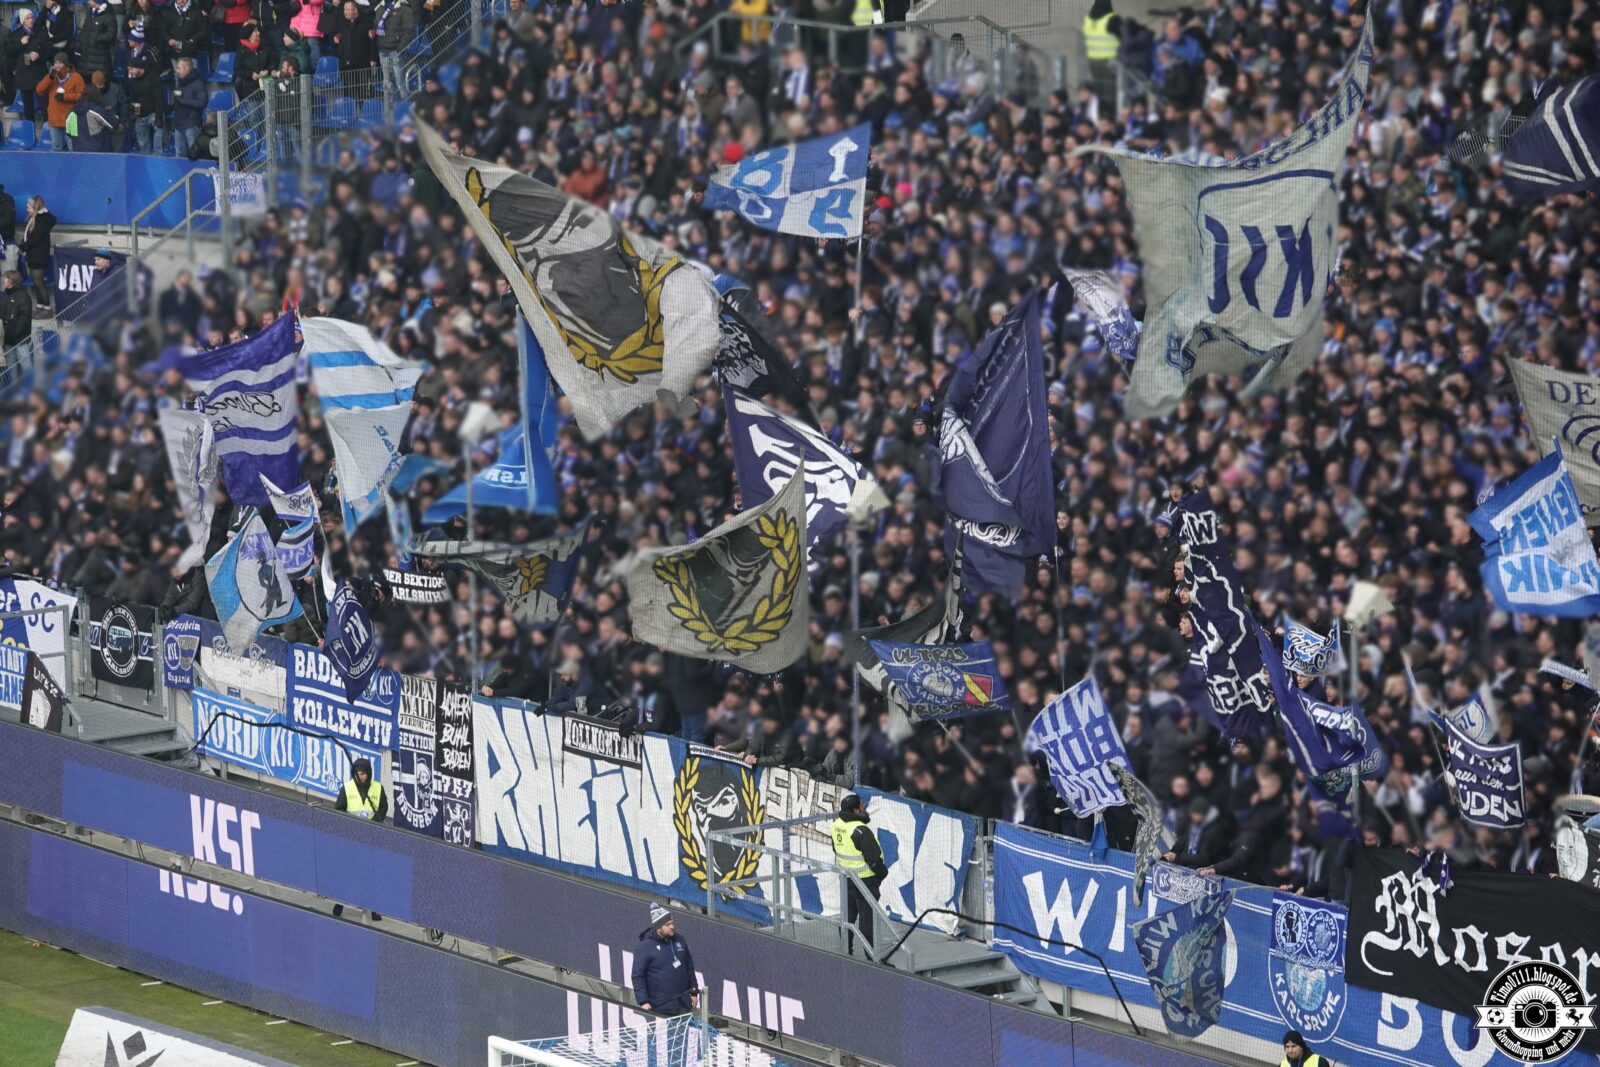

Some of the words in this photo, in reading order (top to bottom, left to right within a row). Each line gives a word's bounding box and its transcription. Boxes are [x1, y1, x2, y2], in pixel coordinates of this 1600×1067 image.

[28, 592, 57, 633] SC
[294, 649, 345, 690] BADE
[891, 647, 969, 664] ULTRAS
[293, 697, 393, 747] KOLLEKTIV
[401, 694, 435, 720] WALD
[197, 697, 259, 760] NORD
[270, 724, 295, 768] KSC
[399, 731, 434, 752] SEKTION
[305, 735, 376, 787] BAD
[1455, 769, 1477, 784] aus
[1459, 784, 1523, 823] ÜDEN
[190, 794, 261, 877] KSC
[1275, 972, 1341, 1032] KARLSRUHE
